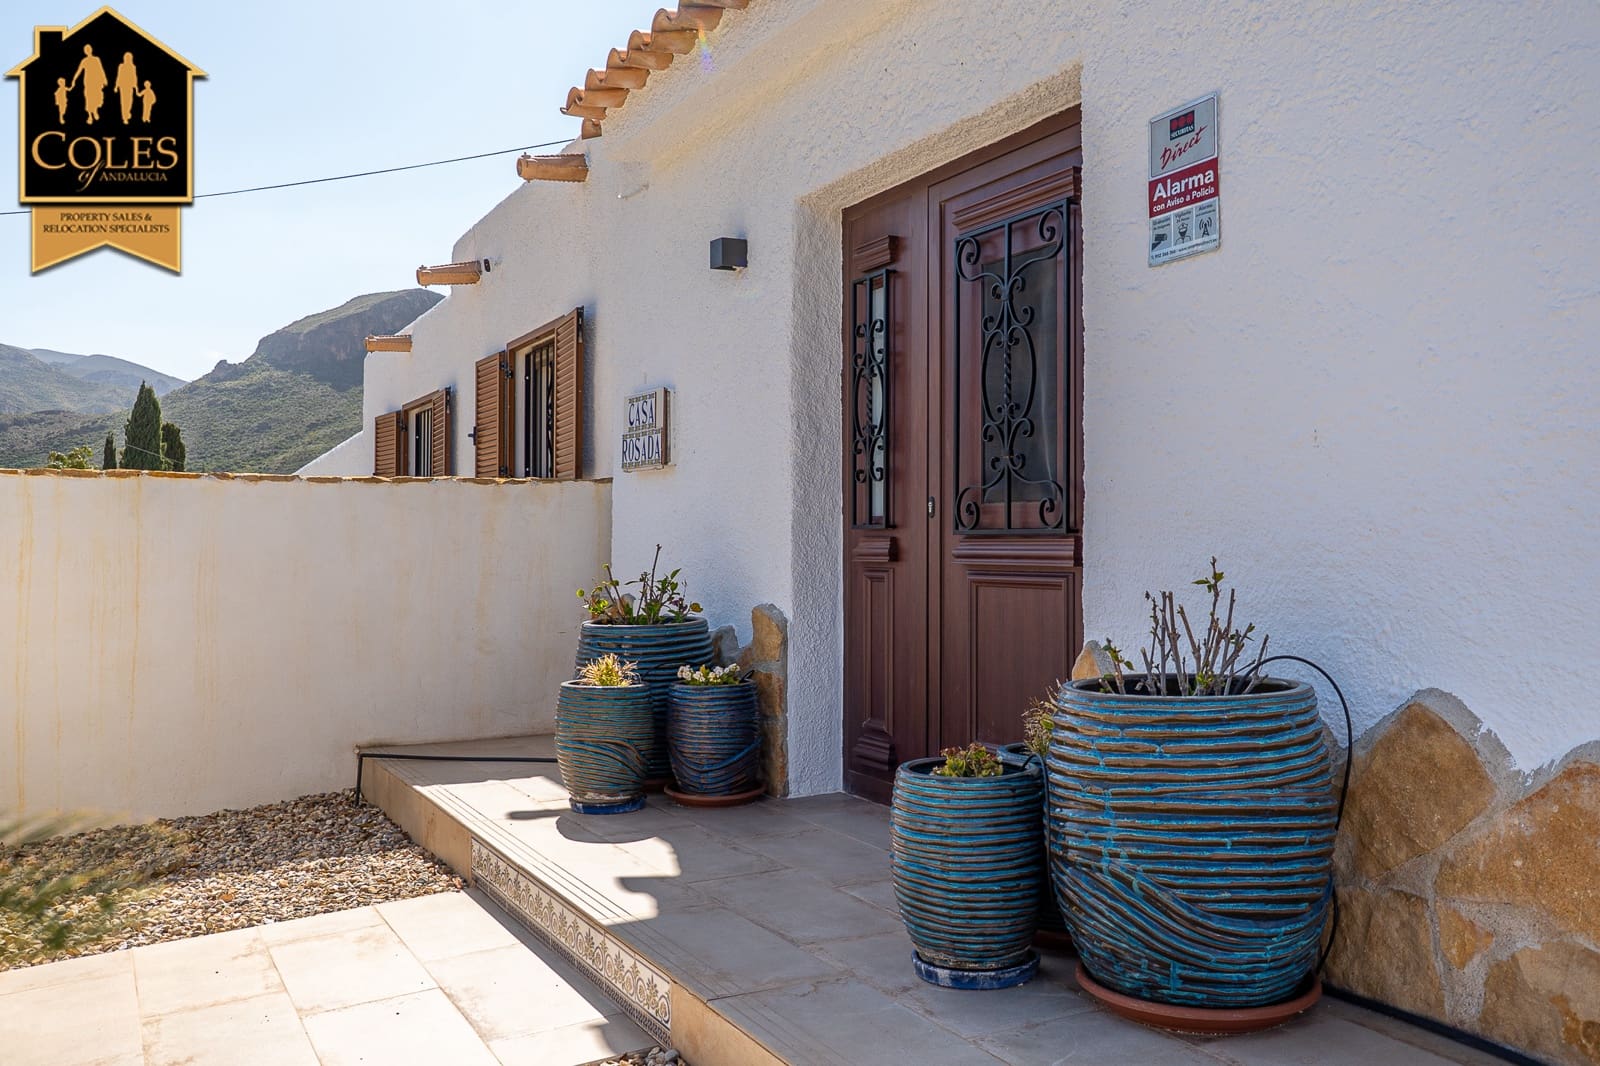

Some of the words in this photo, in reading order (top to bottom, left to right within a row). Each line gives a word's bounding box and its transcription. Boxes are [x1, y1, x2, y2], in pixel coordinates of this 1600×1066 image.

[1160, 125, 1208, 170] Direct
[1152, 169, 1215, 202] Alarma
[1152, 203, 1166, 213] con
[1166, 195, 1184, 209] Aviso
[1185, 194, 1191, 202] a
[628, 399, 654, 426] CASA
[622, 435, 660, 462] ROSADA
